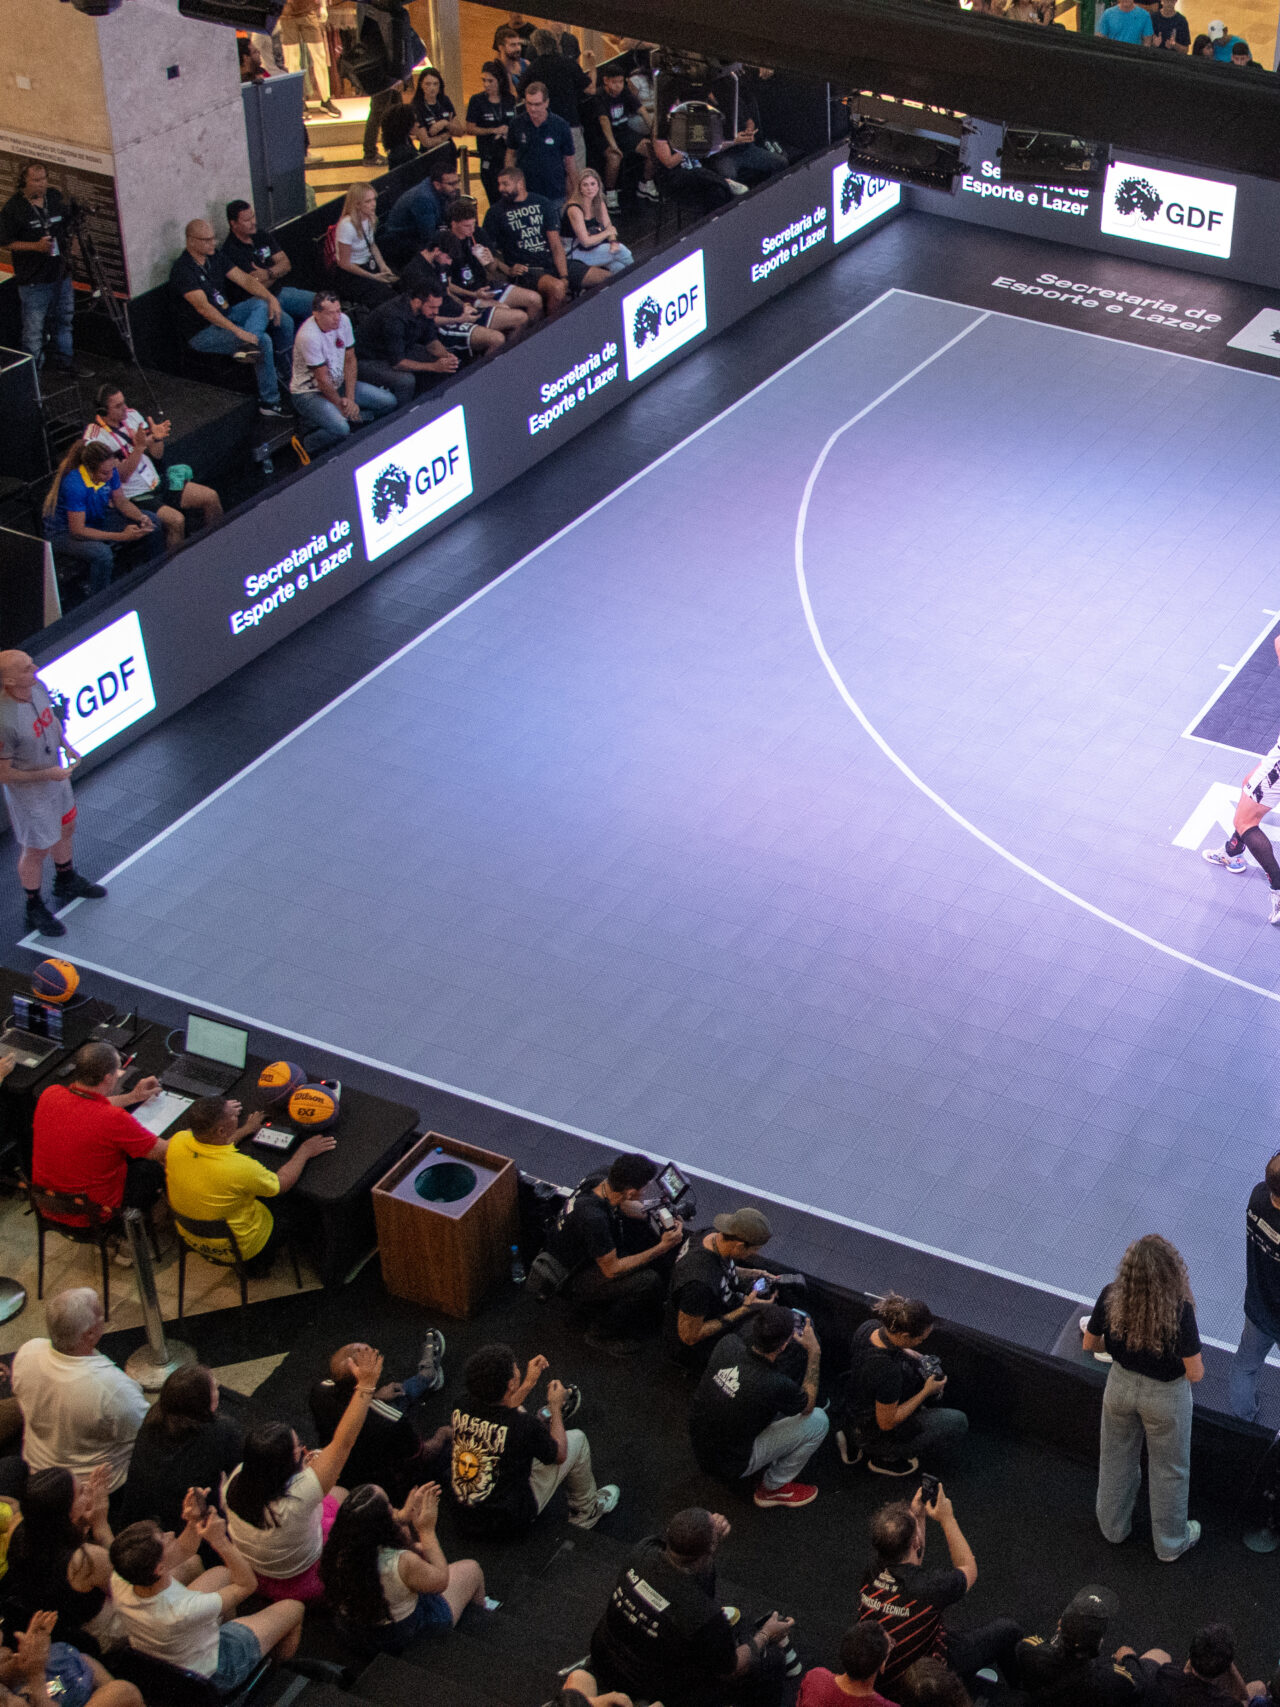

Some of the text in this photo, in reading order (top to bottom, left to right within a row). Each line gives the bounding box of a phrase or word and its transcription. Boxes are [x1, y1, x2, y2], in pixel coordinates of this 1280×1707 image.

[506, 204, 541, 221] SHOOT
[961, 175, 1024, 203] Esporte
[1027, 191, 1039, 206] e
[1042, 193, 1089, 217] Lazer
[1165, 202, 1224, 232] GDF
[508, 214, 544, 231] TIL MY
[761, 205, 827, 256] Secretaria de
[751, 225, 827, 283] Esporte e Lazer
[664, 284, 698, 327] GDF
[991, 275, 1212, 334] Esporte e Lazer
[1036, 273, 1222, 324] Secretaria de
[540, 341, 618, 403] Secretaria de
[528, 362, 620, 435] Esporte e Lazer
[415, 444, 460, 495] GDF
[244, 519, 351, 598] Secretaria de
[229, 541, 355, 635] Esporte e Lazer
[76, 655, 135, 718] GDF
[294, 1092, 325, 1104] Wilson
[882, 1602, 910, 1617] TÉCNICA
